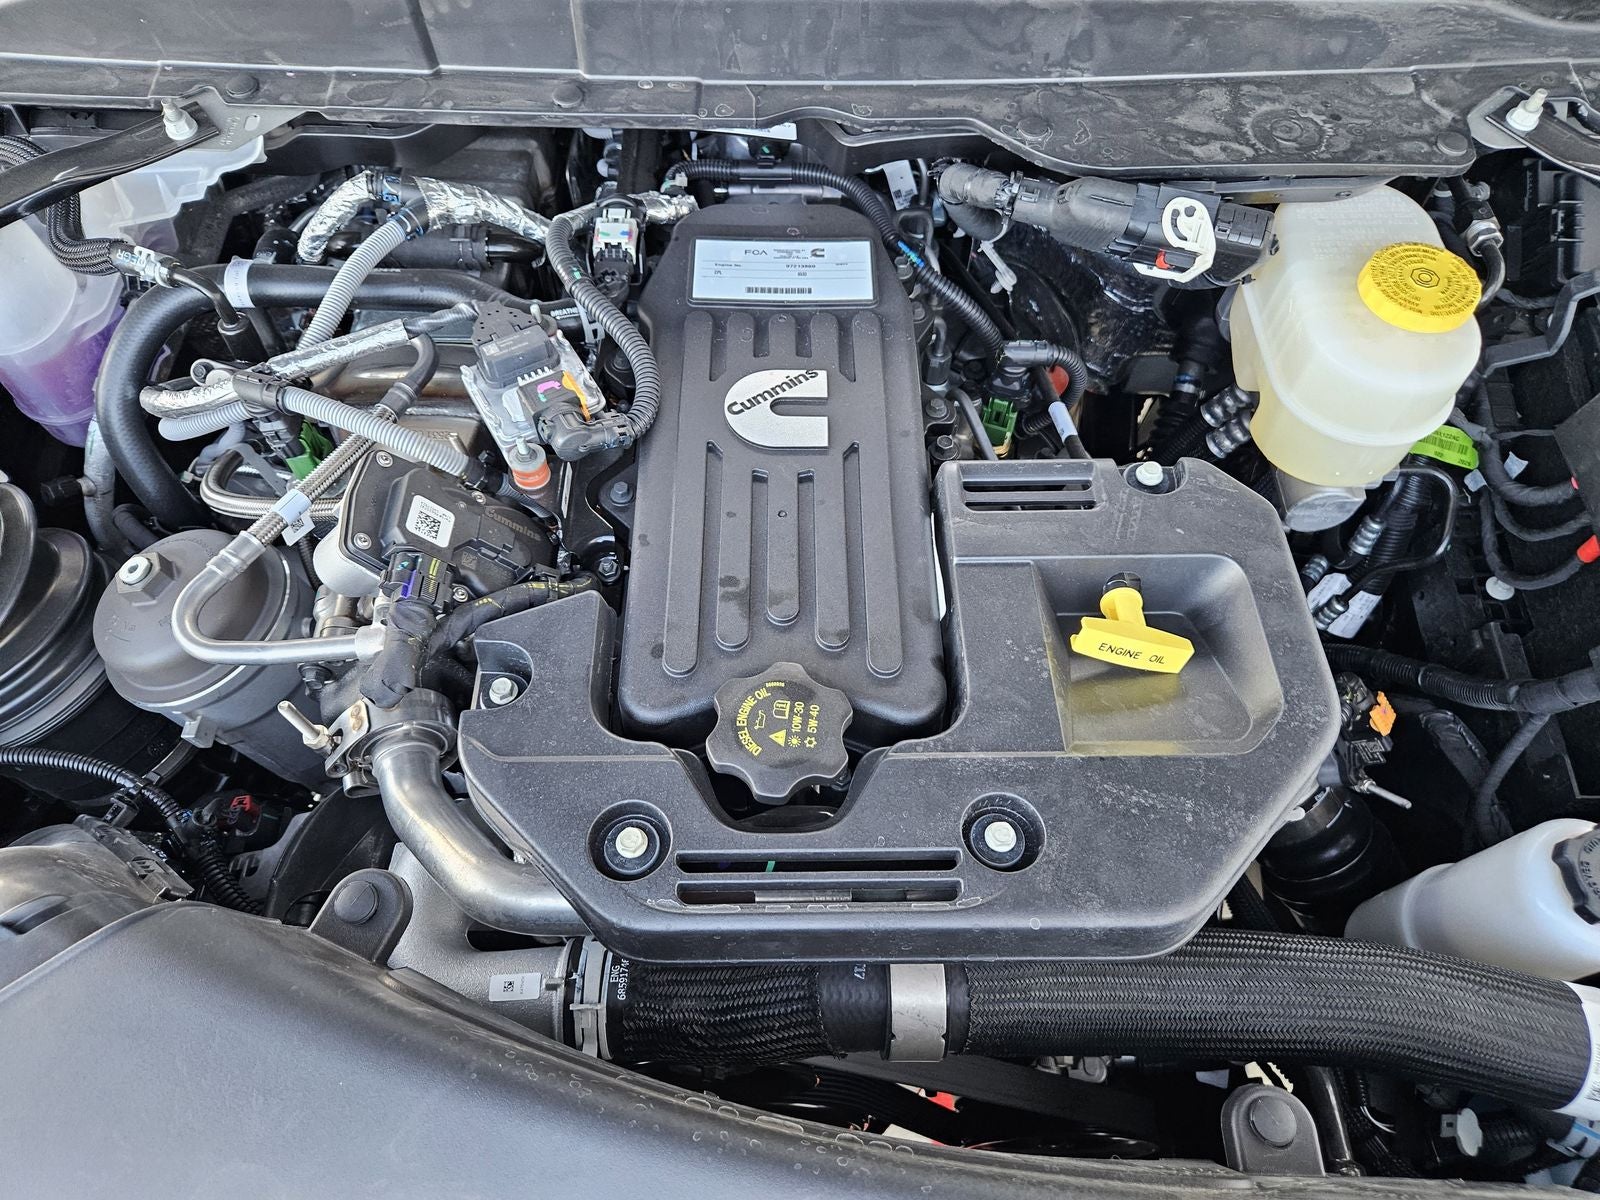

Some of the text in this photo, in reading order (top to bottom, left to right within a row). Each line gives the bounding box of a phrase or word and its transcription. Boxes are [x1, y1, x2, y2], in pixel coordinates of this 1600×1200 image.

[726, 369, 819, 416] Cummins
[484, 506, 542, 541] Cummins
[1098, 642, 1165, 664] ENGINE OIL
[736, 688, 771, 756] DIESEL ENGINE OIL
[791, 701, 805, 733] 10W-30
[807, 704, 820, 733] 5W-40
[610, 965, 620, 982] ENG
